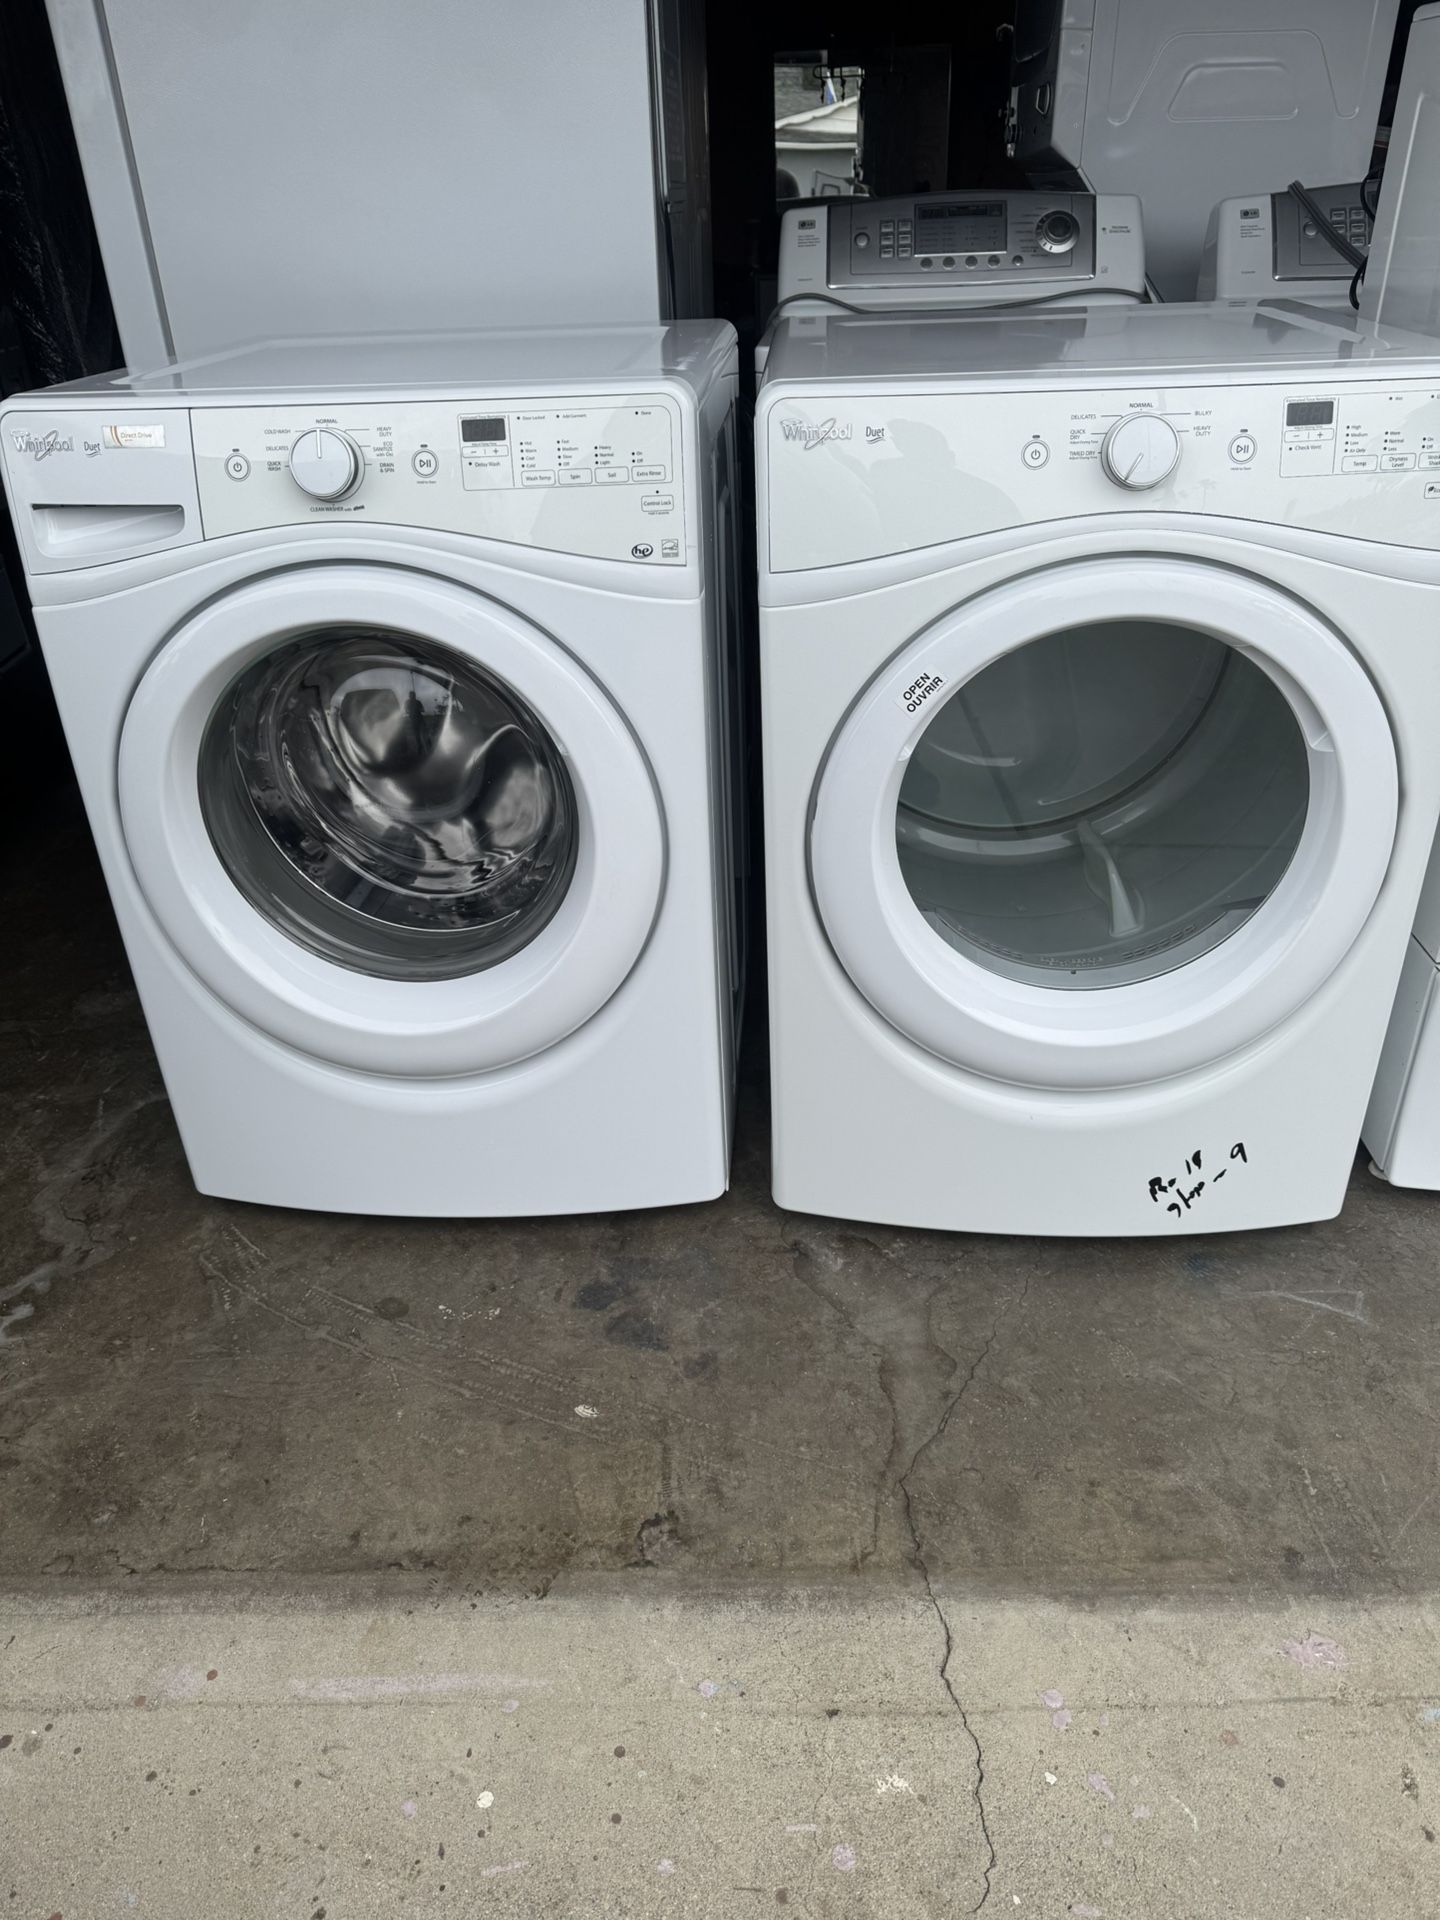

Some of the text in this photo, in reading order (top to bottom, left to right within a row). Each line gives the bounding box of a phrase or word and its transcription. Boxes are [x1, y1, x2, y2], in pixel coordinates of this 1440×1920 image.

[11, 431, 75, 459] Whirlpool
[120, 431, 153, 439] Direct Drive
[780, 419, 852, 449] Whirlpool
[865, 426, 885, 437] Duet
[83, 440, 101, 452] Duet
[902, 672, 931, 701] OPEN
[906, 676, 944, 713] OUVRIR
